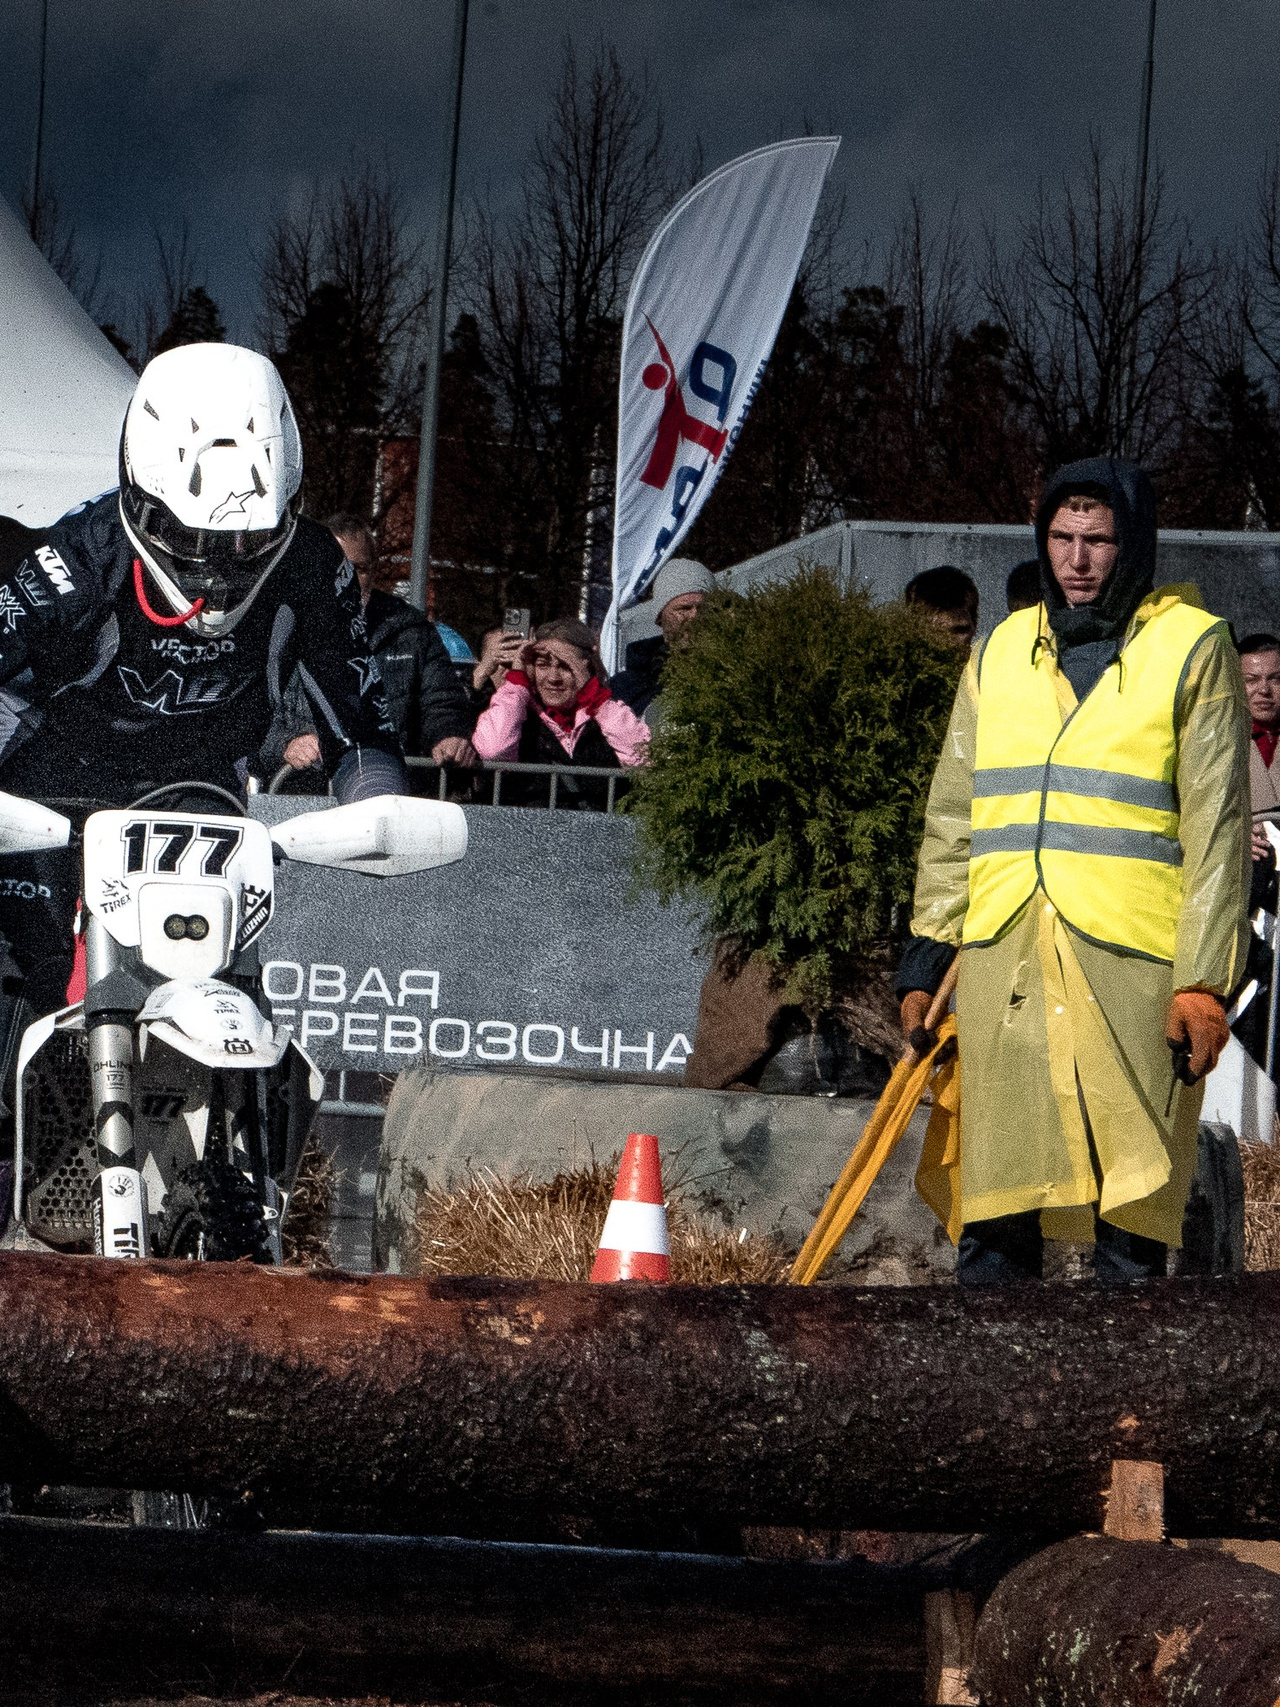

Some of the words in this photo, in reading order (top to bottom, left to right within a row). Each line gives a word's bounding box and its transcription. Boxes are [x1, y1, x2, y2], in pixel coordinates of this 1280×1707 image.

[34, 545, 75, 595] KTM
[120, 819, 244, 878] 177
[262, 960, 440, 1009] ОВАЯ
[142, 1094, 188, 1118] 177
